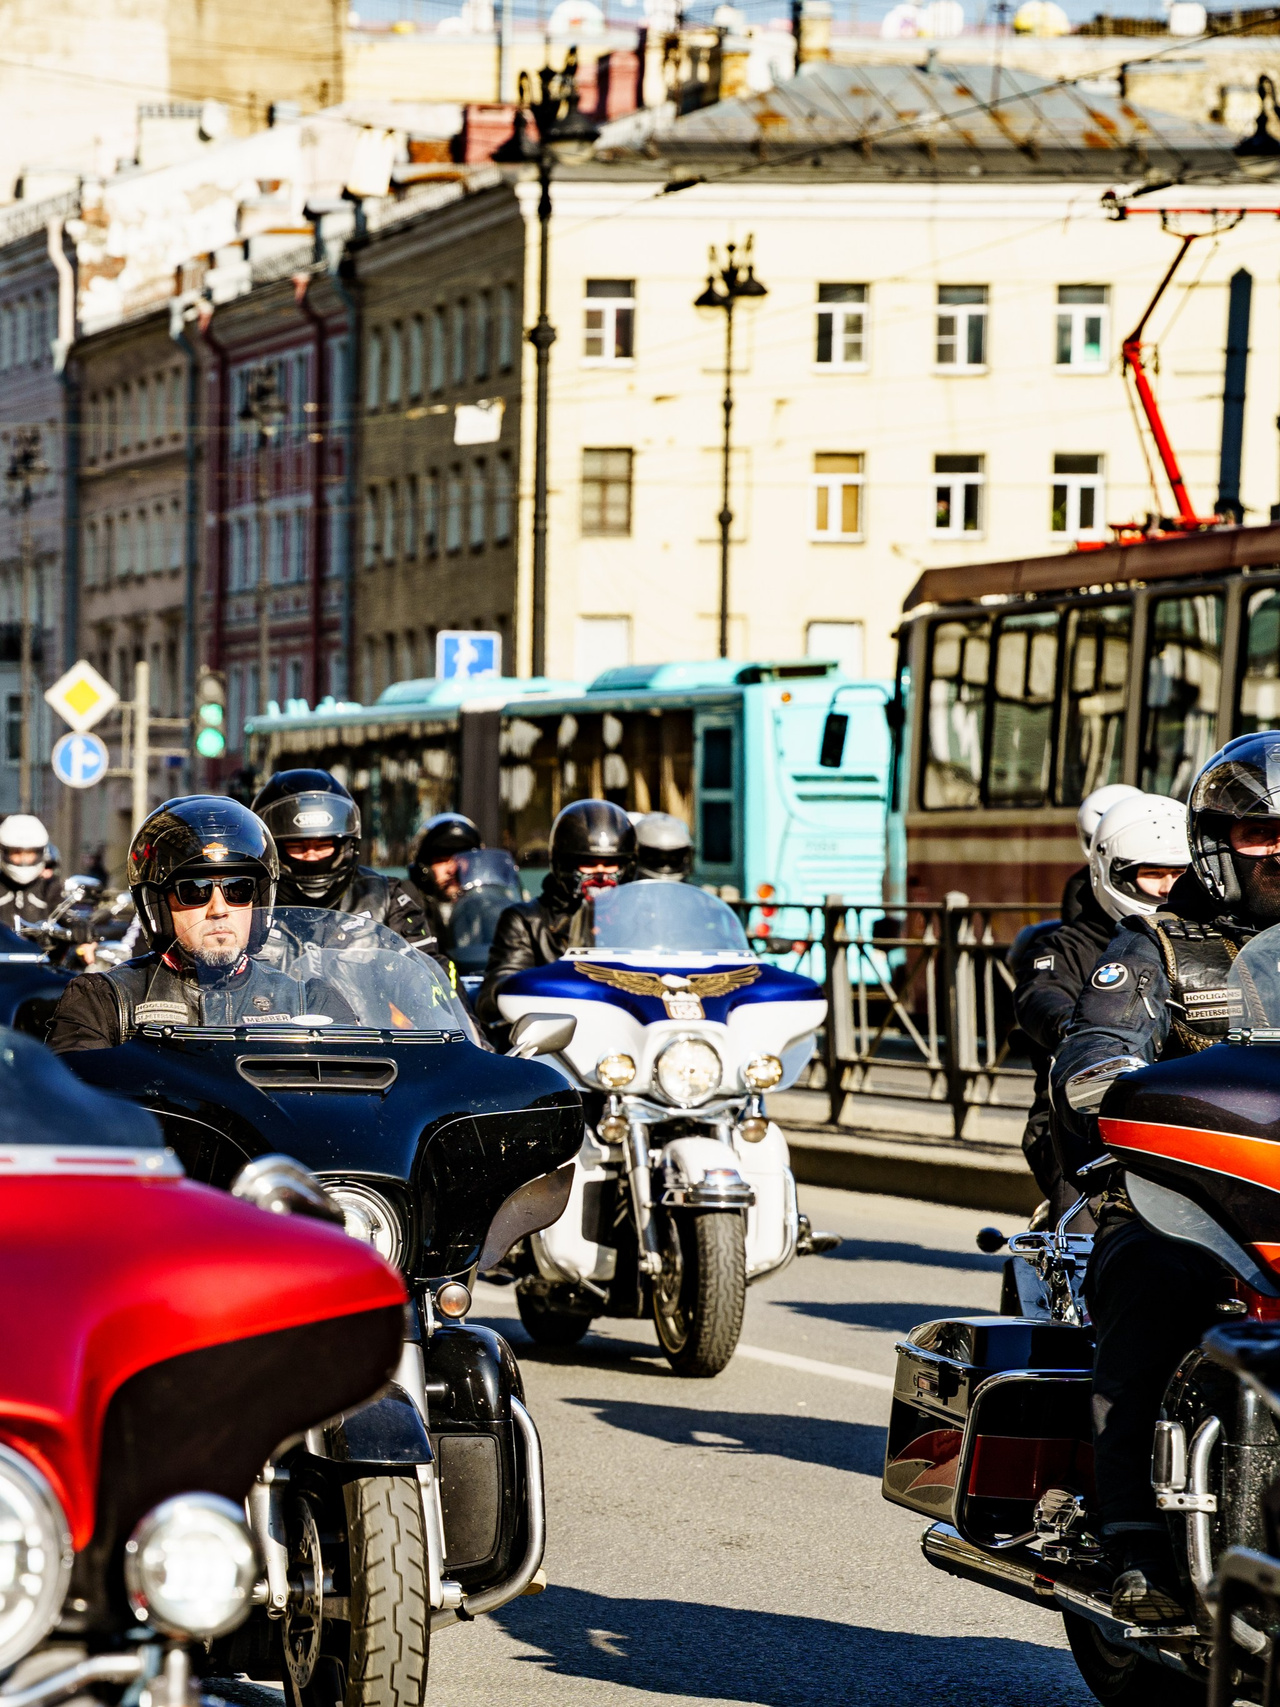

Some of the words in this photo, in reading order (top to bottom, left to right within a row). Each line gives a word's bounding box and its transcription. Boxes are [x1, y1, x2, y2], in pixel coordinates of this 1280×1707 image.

[1185, 990, 1241, 1003] HOOLIGANS
[137, 1003, 185, 1011] HOOLIGANS
[246, 1014, 289, 1023] MEMBER
